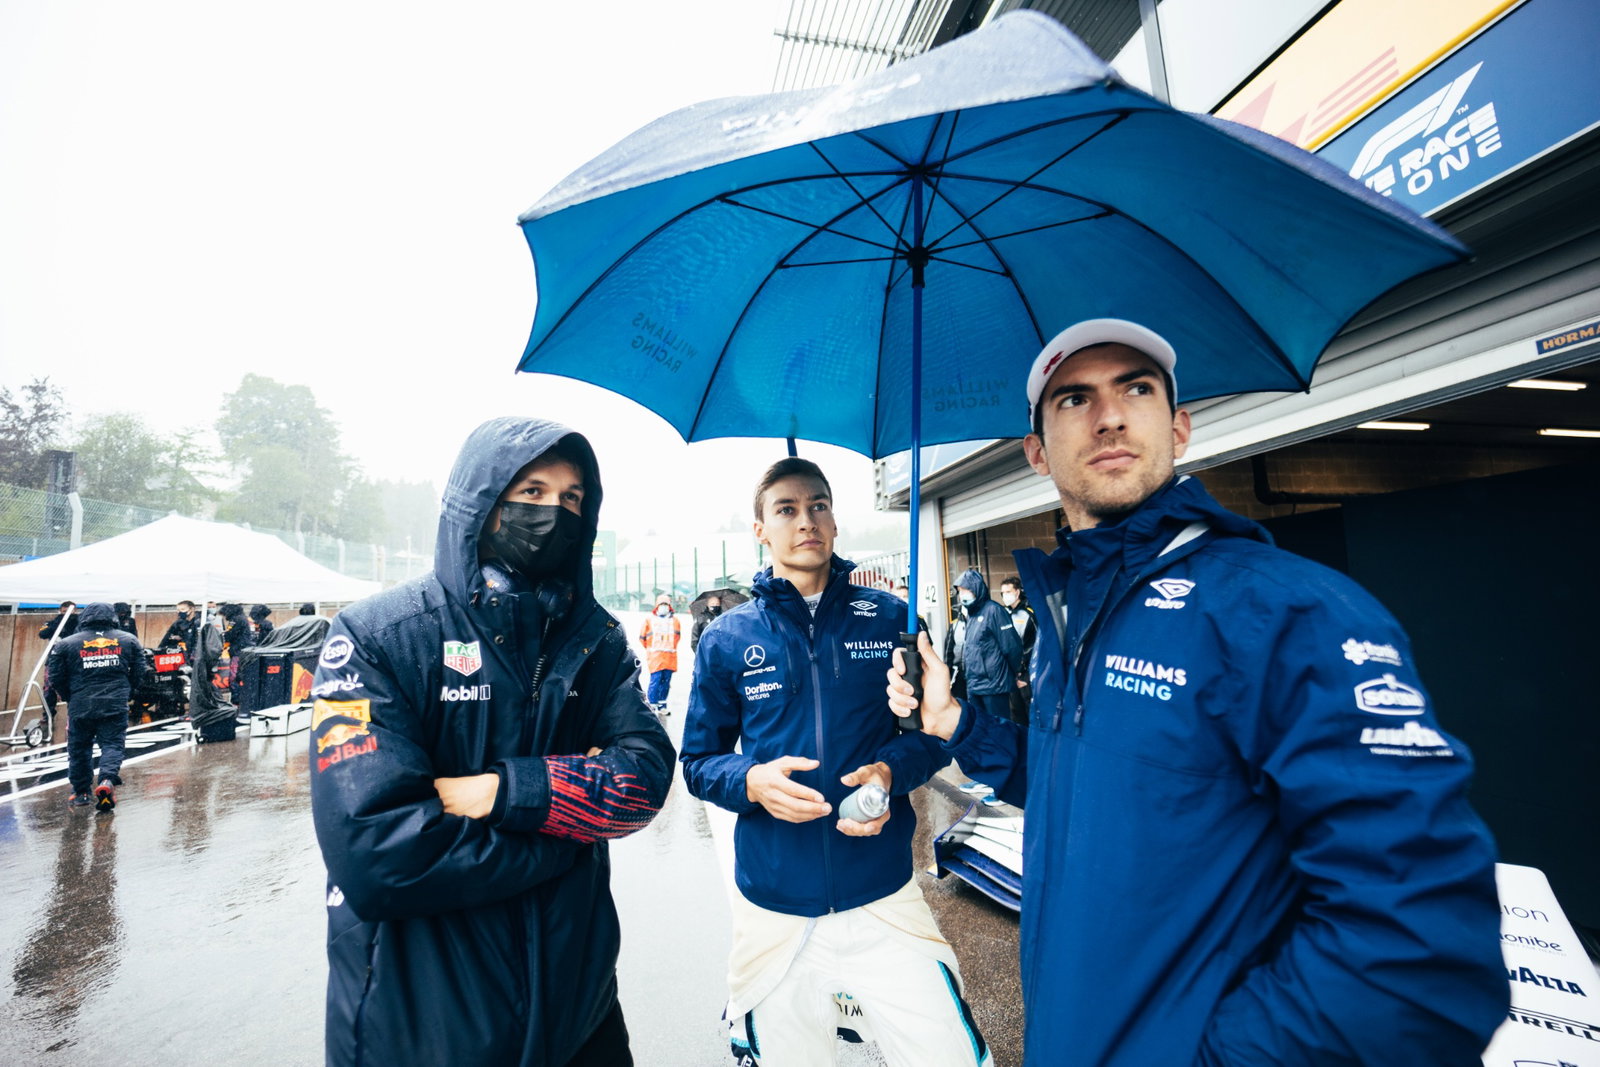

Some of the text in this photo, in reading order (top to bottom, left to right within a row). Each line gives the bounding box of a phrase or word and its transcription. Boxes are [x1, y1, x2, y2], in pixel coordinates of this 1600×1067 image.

[1399, 102, 1497, 179] RACE
[1407, 126, 1503, 196] ONE
[853, 610, 877, 618] umbro
[449, 643, 478, 656] TAG
[844, 641, 893, 650] WILLIAMS
[80, 647, 122, 658] Red Bull
[851, 650, 888, 659] RACING
[83, 660, 110, 669] Mobil
[159, 655, 182, 665] ESSO
[446, 656, 483, 675] HEUER
[1105, 655, 1187, 686] WILLIAMS
[1105, 673, 1172, 701] RACING
[746, 692, 770, 701] Ventures
[342, 736, 377, 760] Bull
